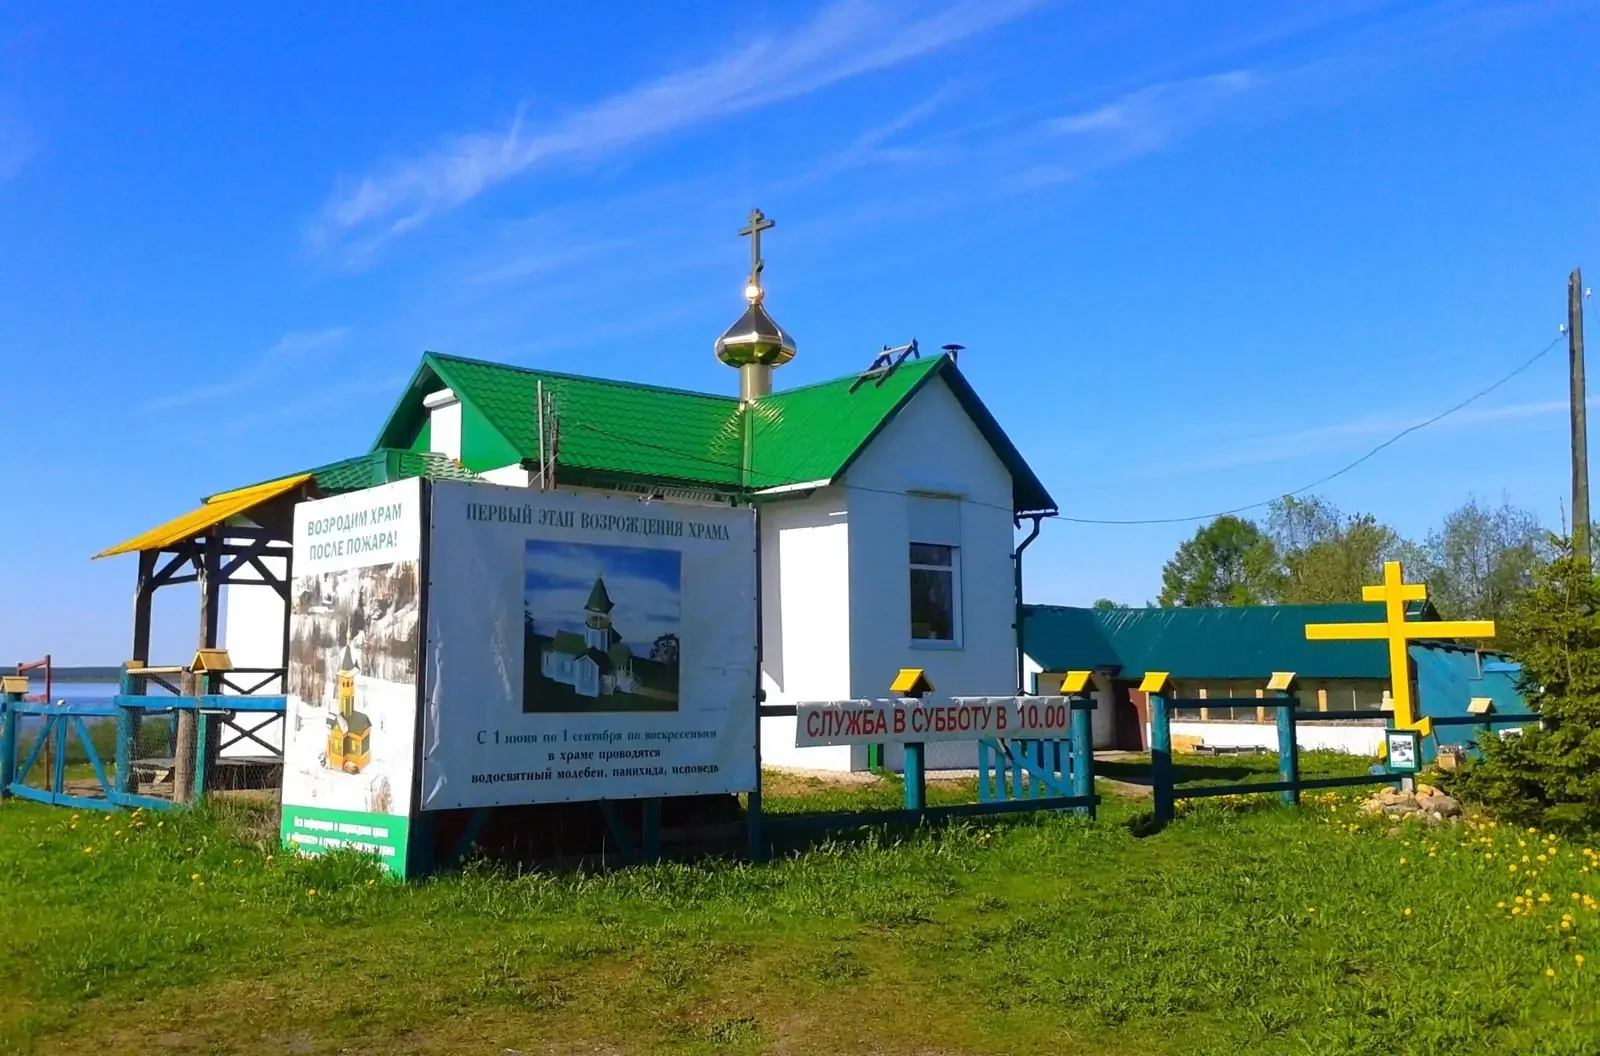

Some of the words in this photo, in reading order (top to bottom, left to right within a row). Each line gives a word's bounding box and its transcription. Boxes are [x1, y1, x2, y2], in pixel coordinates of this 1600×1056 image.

[308, 510, 367, 536] ВОЗРОДИМ
[370, 502, 402, 525] ХРАМ
[466, 503, 532, 524] ПЕРВЫЙ
[538, 509, 574, 527] ЭТАП
[581, 512, 683, 537] ВОЗРОЖДЕНИЯ
[688, 522, 730, 540] ХРАМА
[309, 540, 344, 561] ПОСЛЕ
[346, 530, 398, 555] ПОЖАРА!
[477, 730, 487, 744] С
[494, 730, 500, 744] 1
[505, 734, 537, 744] июня
[543, 734, 557, 743] по
[563, 728, 568, 742] 1
[572, 730, 622, 744] сентября
[627, 732, 640, 740] по
[645, 730, 717, 743] воскресеньям
[806, 708, 888, 738] СЛУЖБА
[893, 708, 906, 734] В
[912, 705, 991, 733] СУББОТУ
[996, 704, 1008, 729] В
[1016, 704, 1066, 730] 10.00
[548, 752, 555, 761] в
[560, 751, 594, 763] храме
[599, 749, 661, 762] проводятся
[471, 767, 552, 784] водосвятный
[557, 766, 608, 778] молебен,
[612, 766, 667, 777] панихида,
[672, 764, 719, 775] исповедь
